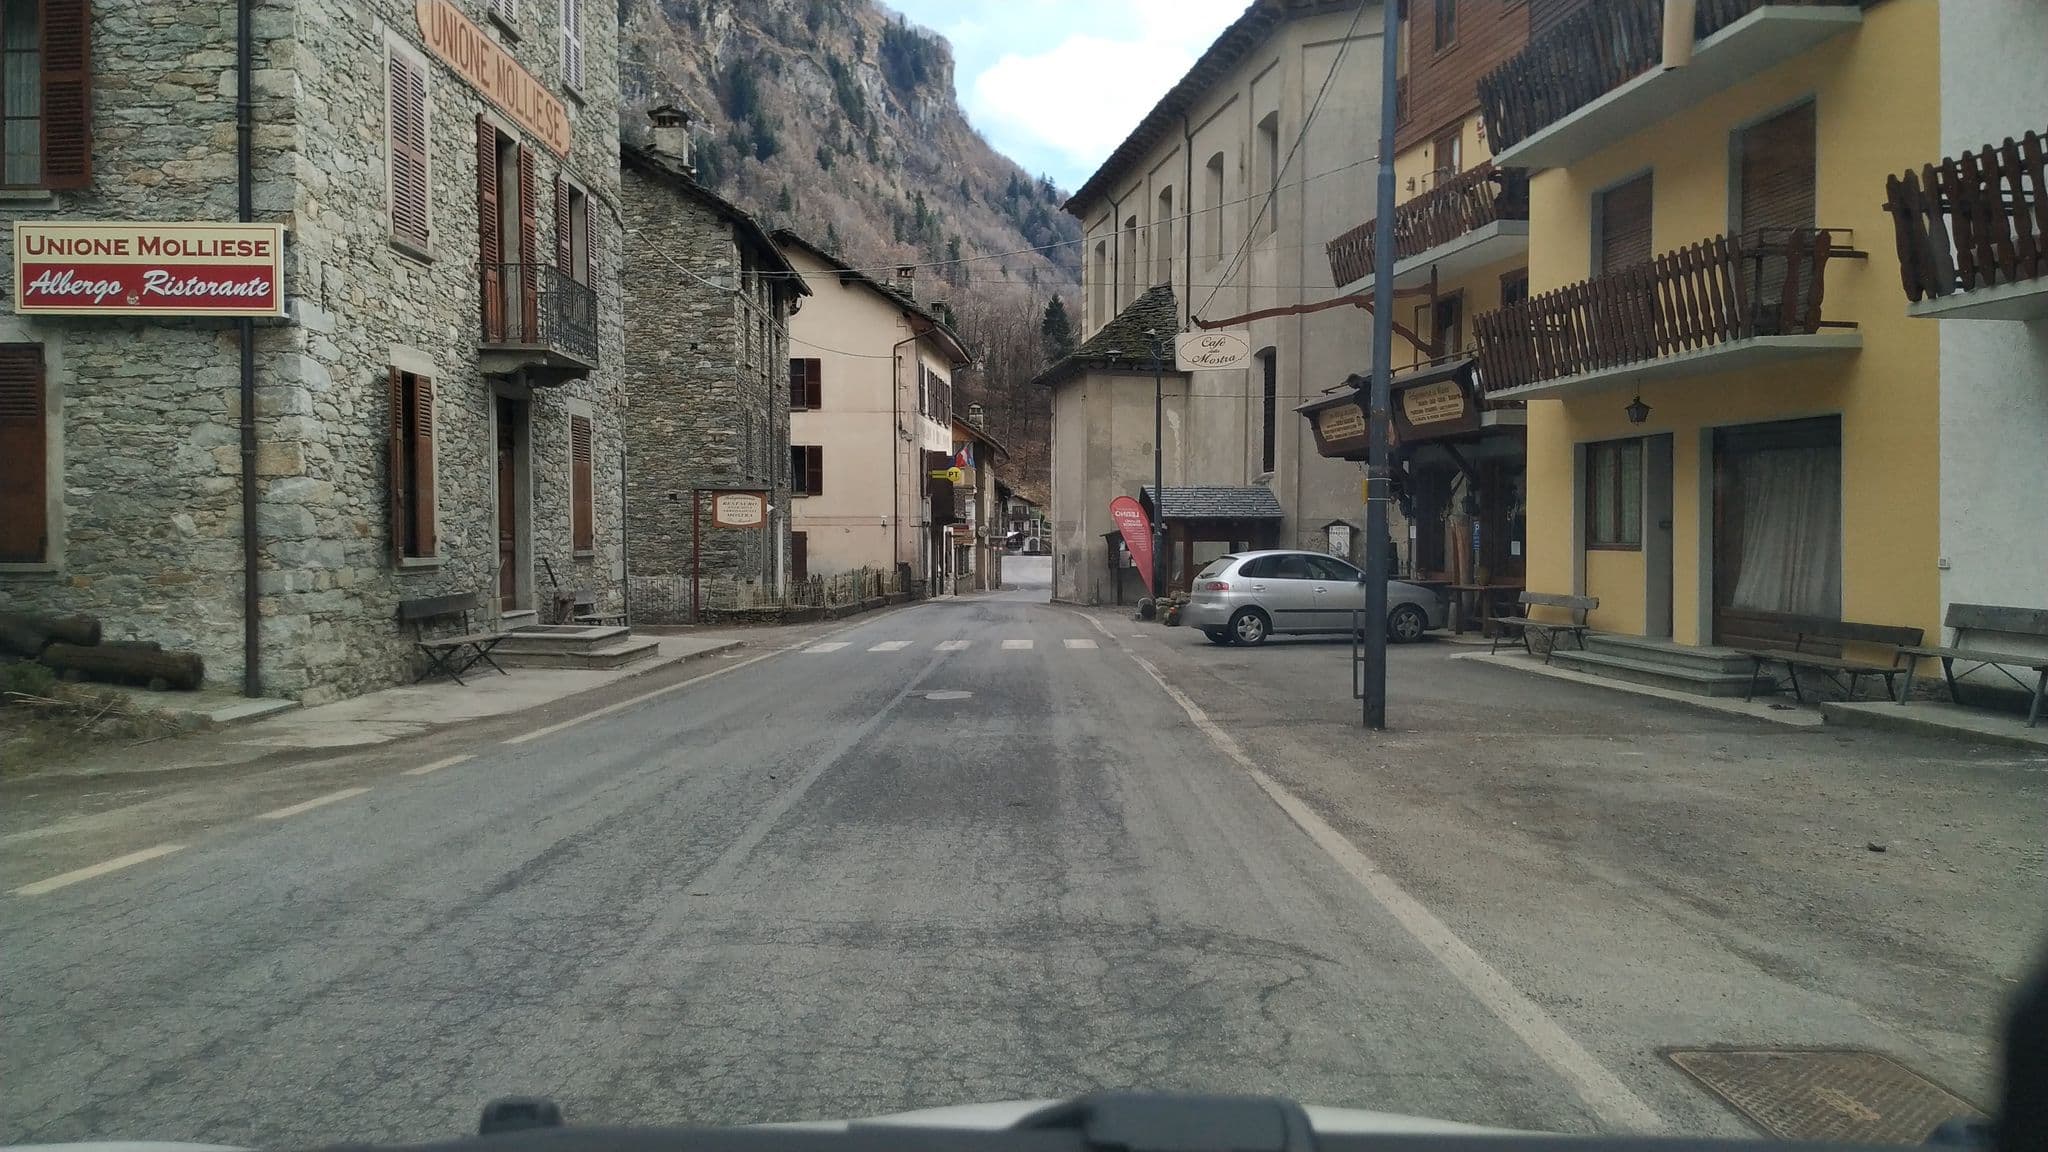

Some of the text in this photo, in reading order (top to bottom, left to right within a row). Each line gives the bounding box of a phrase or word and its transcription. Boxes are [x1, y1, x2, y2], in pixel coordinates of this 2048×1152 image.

[431, 0, 562, 149] UNIONE MOLLIESE
[25, 235, 271, 257] UNIONE MOLLIESE
[26, 269, 271, 304] Albergo Ristorante
[1192, 354, 1236, 364] Mostra
